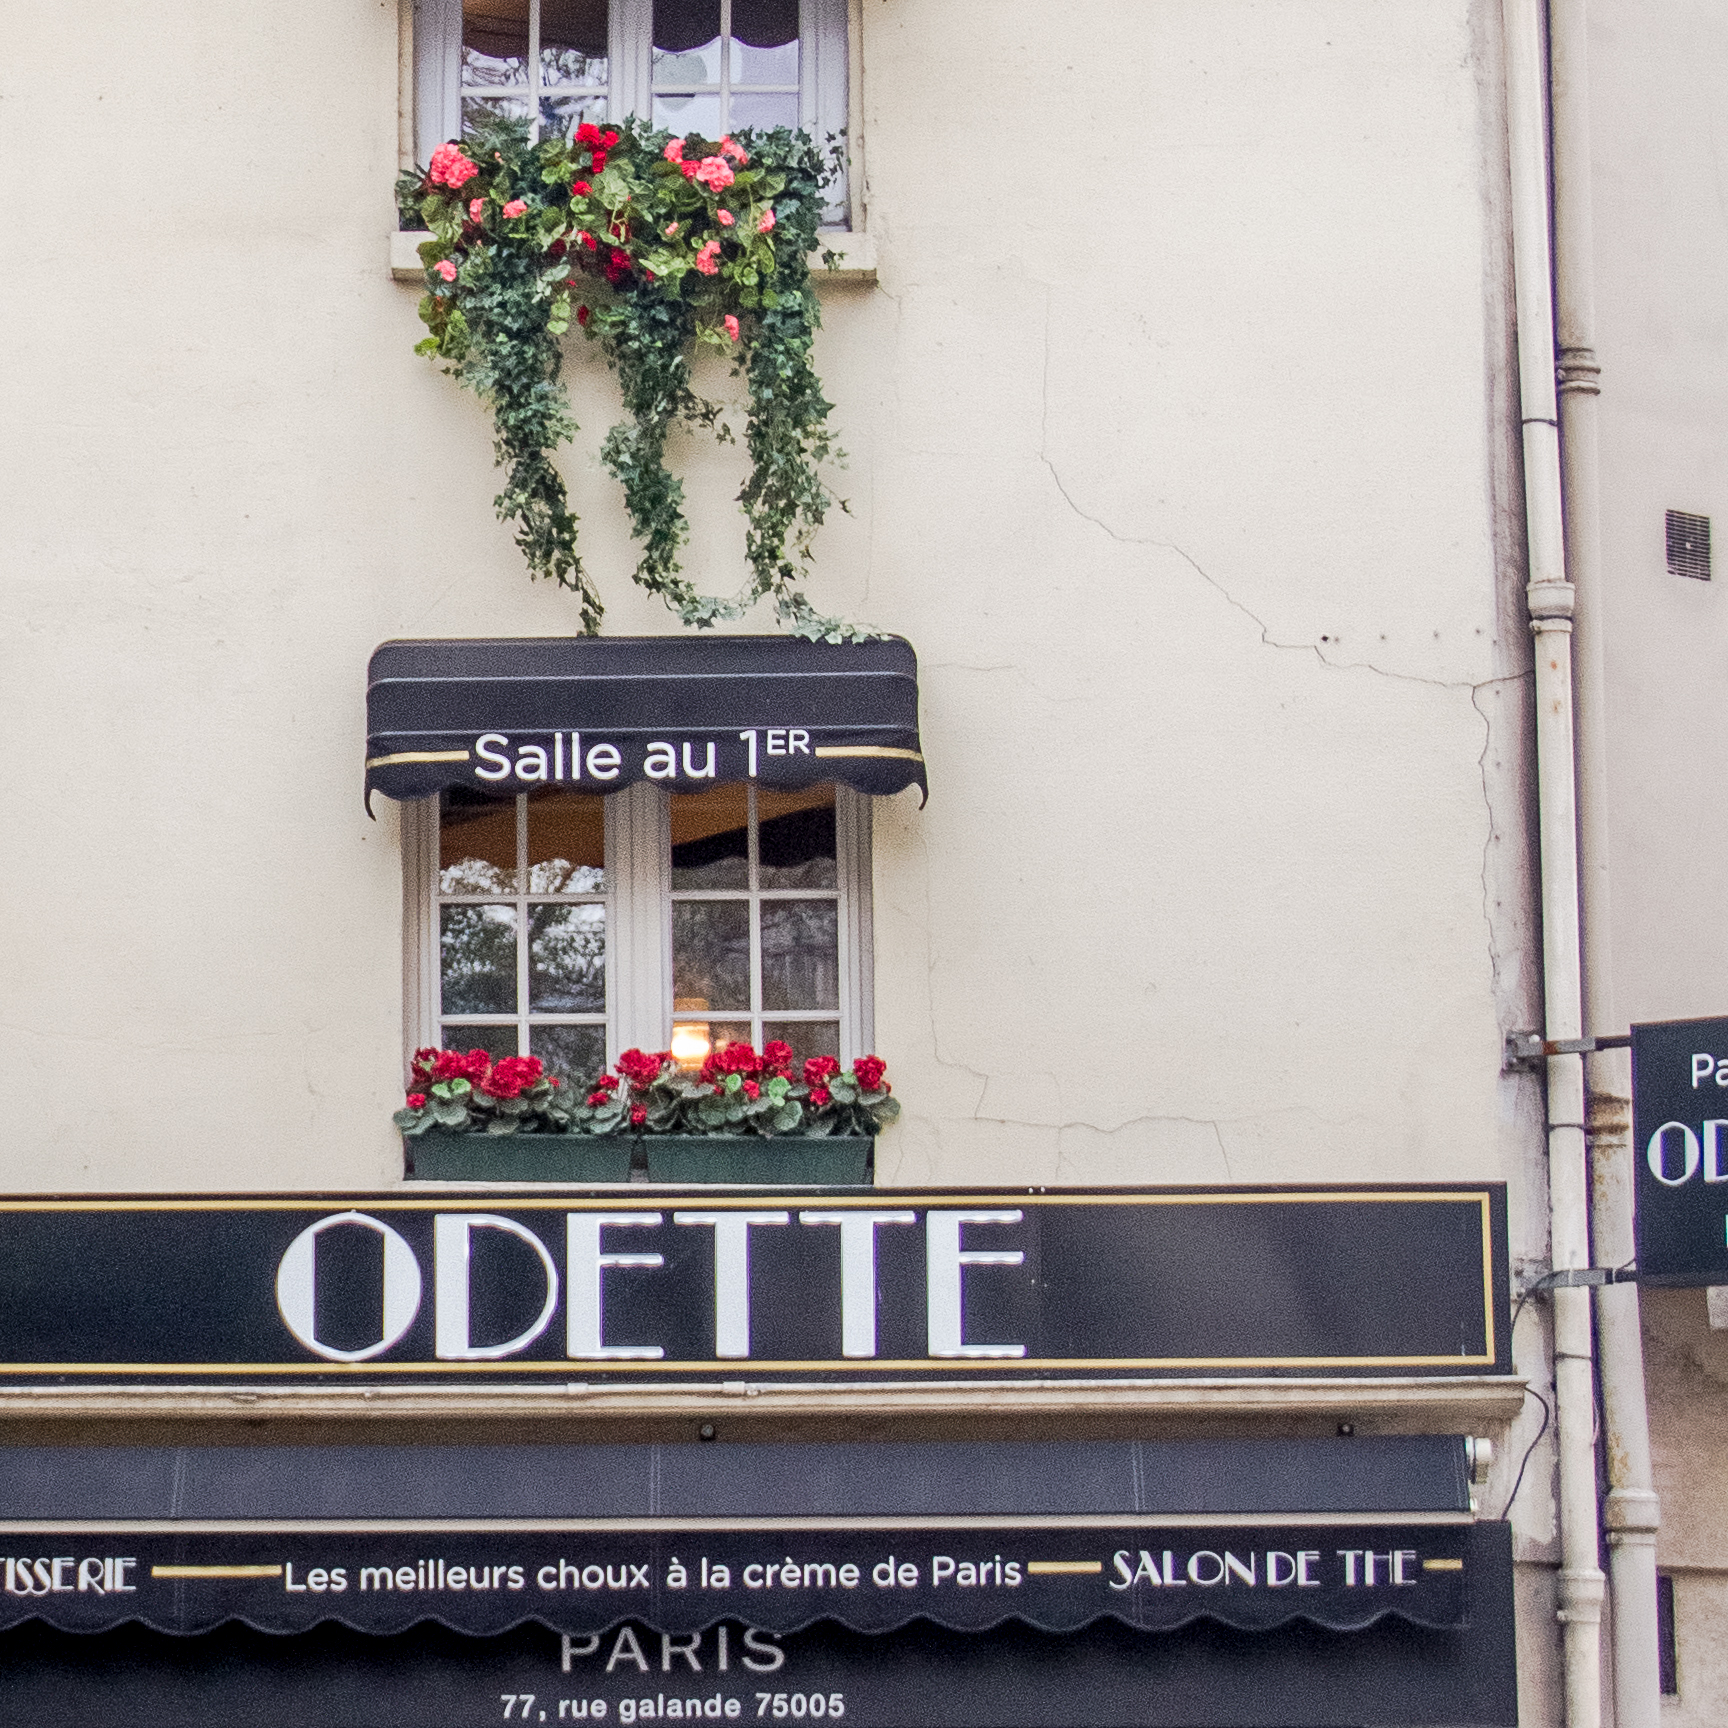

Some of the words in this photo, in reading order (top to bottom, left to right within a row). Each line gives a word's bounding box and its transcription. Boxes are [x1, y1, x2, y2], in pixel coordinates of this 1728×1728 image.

[475, 732, 621, 780] Salle
[643, 740, 716, 779] au
[739, 729, 810, 778] 1ER
[277, 1209, 1026, 1362] ODETTE
[285, 1562, 347, 1591] Les
[360, 1559, 525, 1591] meilleurs
[537, 1558, 650, 1590] choux
[667, 1557, 687, 1589] à
[701, 1557, 731, 1589] la
[743, 1556, 860, 1589] crème
[873, 1555, 919, 1588] de
[932, 1554, 1022, 1588] Paris
[1109, 1550, 1256, 1589] SALON
[1267, 1550, 1320, 1587] DE
[1337, 1550, 1417, 1586] THE
[561, 1626, 785, 1672] PARIS
[500, 1694, 546, 1722] 77,
[558, 1698, 608, 1719] rue
[619, 1693, 742, 1722] galande
[755, 1692, 845, 1718] 75005
